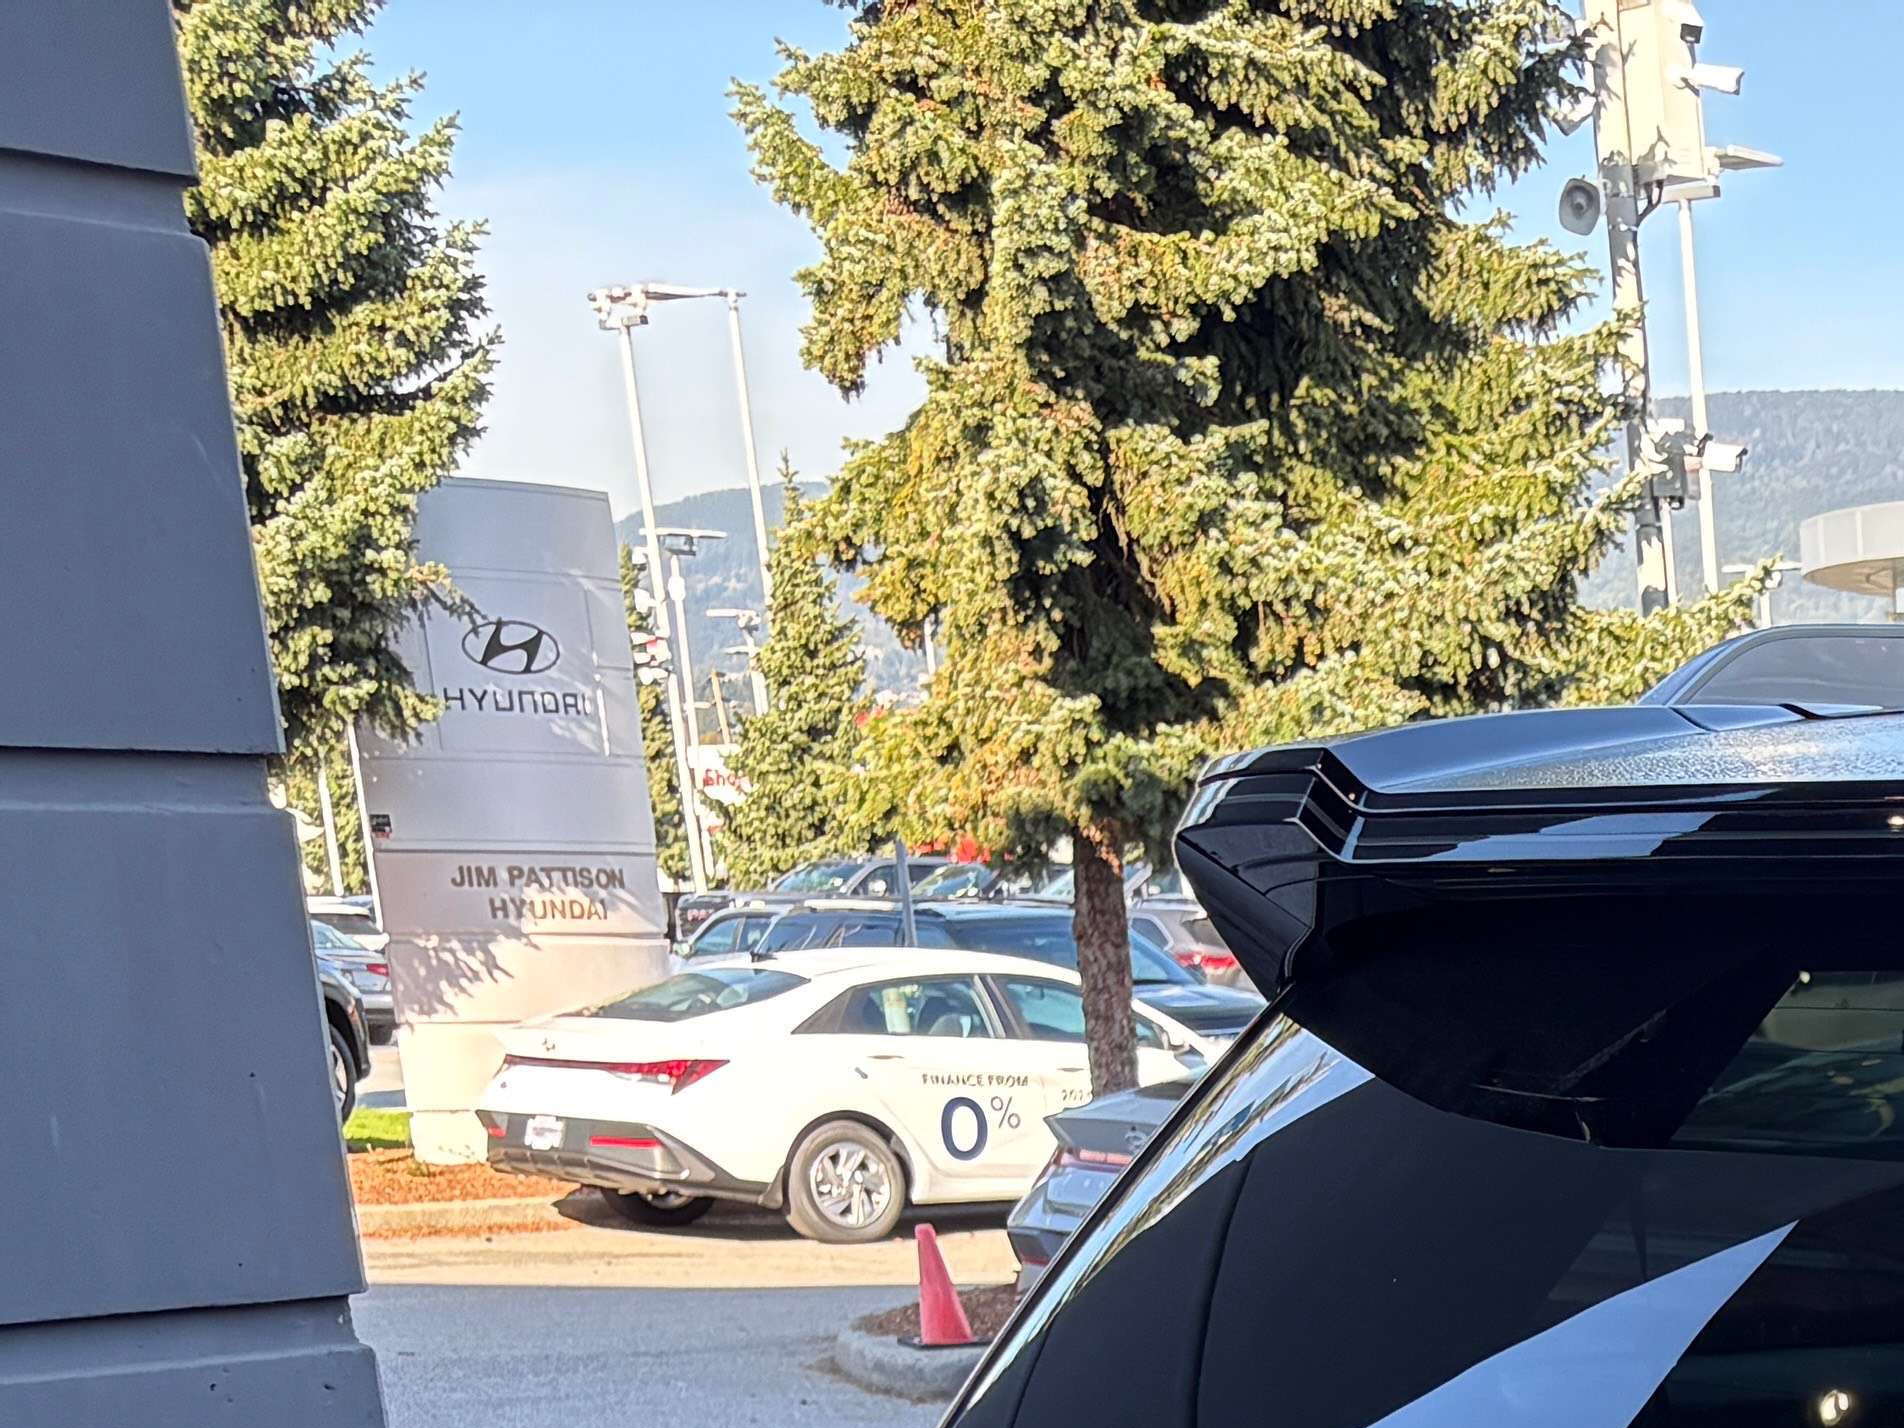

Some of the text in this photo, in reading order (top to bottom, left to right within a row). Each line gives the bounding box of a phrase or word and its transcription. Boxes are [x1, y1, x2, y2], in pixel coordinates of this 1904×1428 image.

[443, 687, 591, 717] HYUNDAI
[451, 865, 626, 890] JIM PATTISON
[488, 896, 609, 921] HYUNDAI
